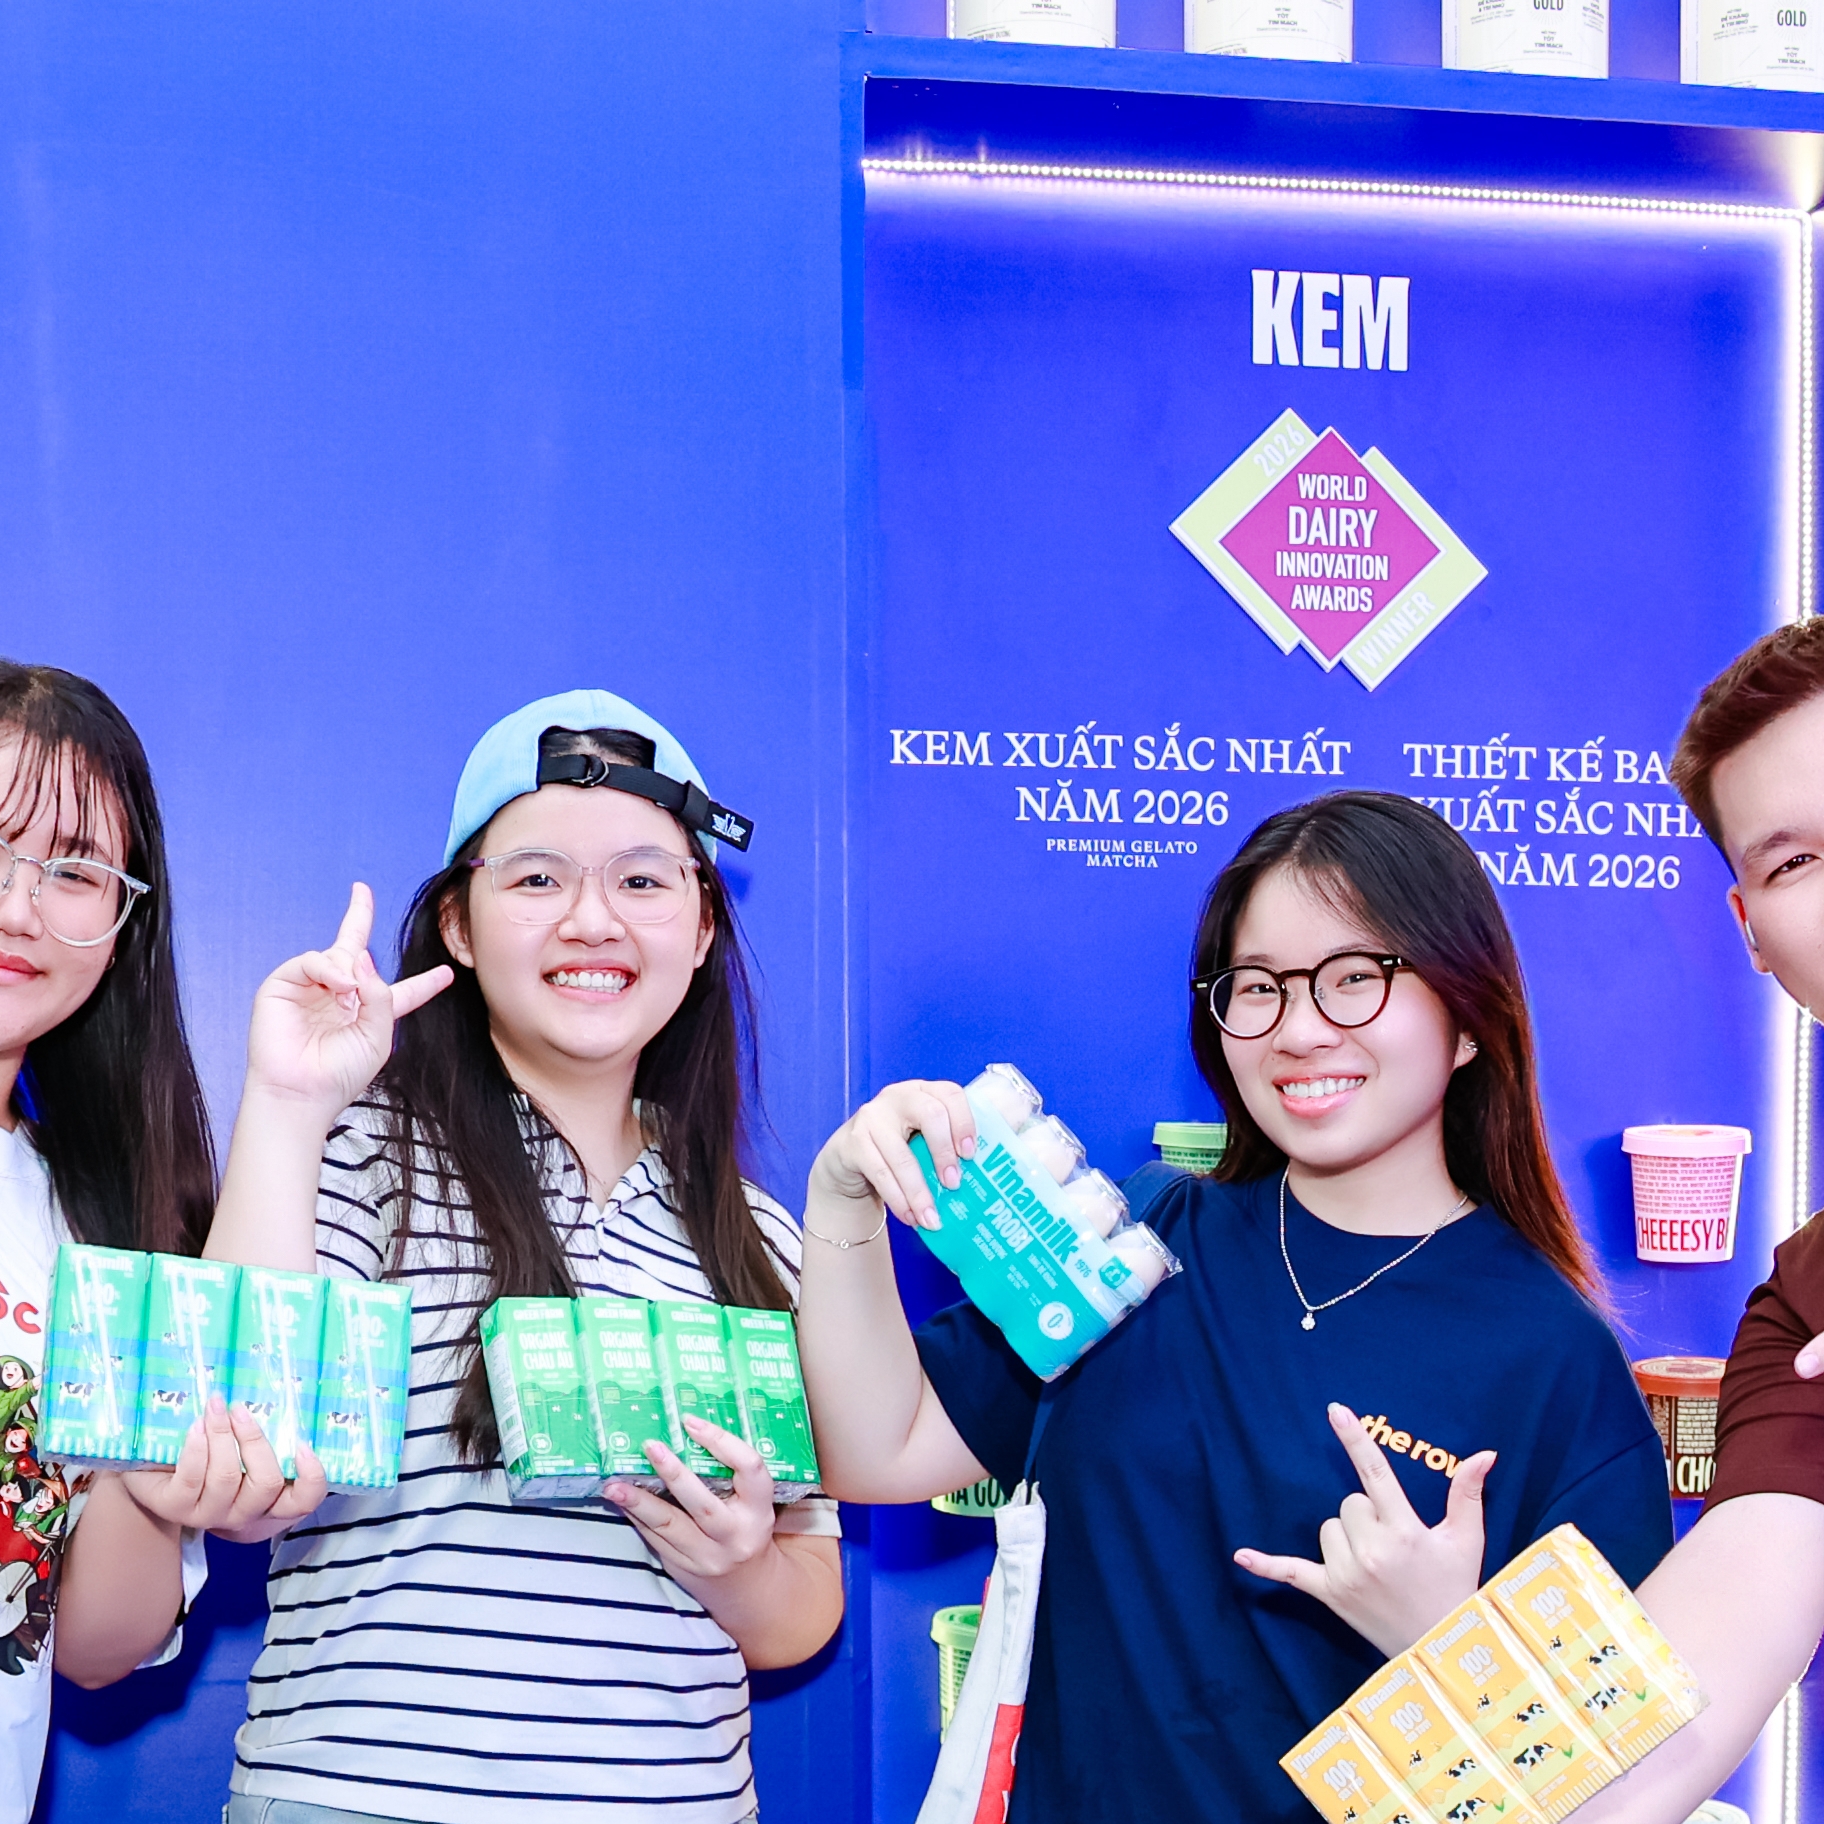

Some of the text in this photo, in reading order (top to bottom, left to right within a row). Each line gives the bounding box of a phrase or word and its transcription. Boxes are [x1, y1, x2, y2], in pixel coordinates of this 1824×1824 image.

[1777, 10, 1807, 27] GOLD
[1252, 270, 1410, 371] KEM
[1253, 423, 1306, 477] 2026
[1297, 473, 1367, 501] WORLD
[1288, 505, 1377, 548] DAIRY
[1276, 551, 1389, 581] INNOVATION
[1290, 584, 1373, 612] AWARDS
[1355, 590, 1436, 669] WINNER
[890, 721, 1351, 775] KEM XUẤT SẮC NHẤT
[1403, 733, 1669, 784] THIẾT KẾ BA
[1016, 779, 1228, 825] NĂM 2026
[1535, 787, 1613, 835] SẮC
[1624, 802, 1703, 837] NH
[1047, 839, 1197, 854] PREMIUM GELATO
[1087, 854, 1158, 868] MATCHA
[1480, 844, 1680, 889] NĂM 2026
[982, 1143, 1080, 1266] Vinamilk
[983, 1199, 1035, 1254] PROBI
[1074, 1258, 1092, 1279] 1976
[519, 1330, 570, 1350] ORGANIC
[599, 1330, 647, 1349] ORGANIC
[676, 1333, 723, 1354] ORGANIC
[746, 1340, 792, 1360] ORGANIC
[1360, 1415, 1412, 1453] the
[1677, 1456, 1716, 1493] CHO
[1494, 1550, 1558, 1602] Vinamilk
[1423, 1609, 1482, 1660] Vinamilk
[1356, 1667, 1413, 1719] Vinamilk
[1290, 1725, 1346, 1774] Vinamilk
